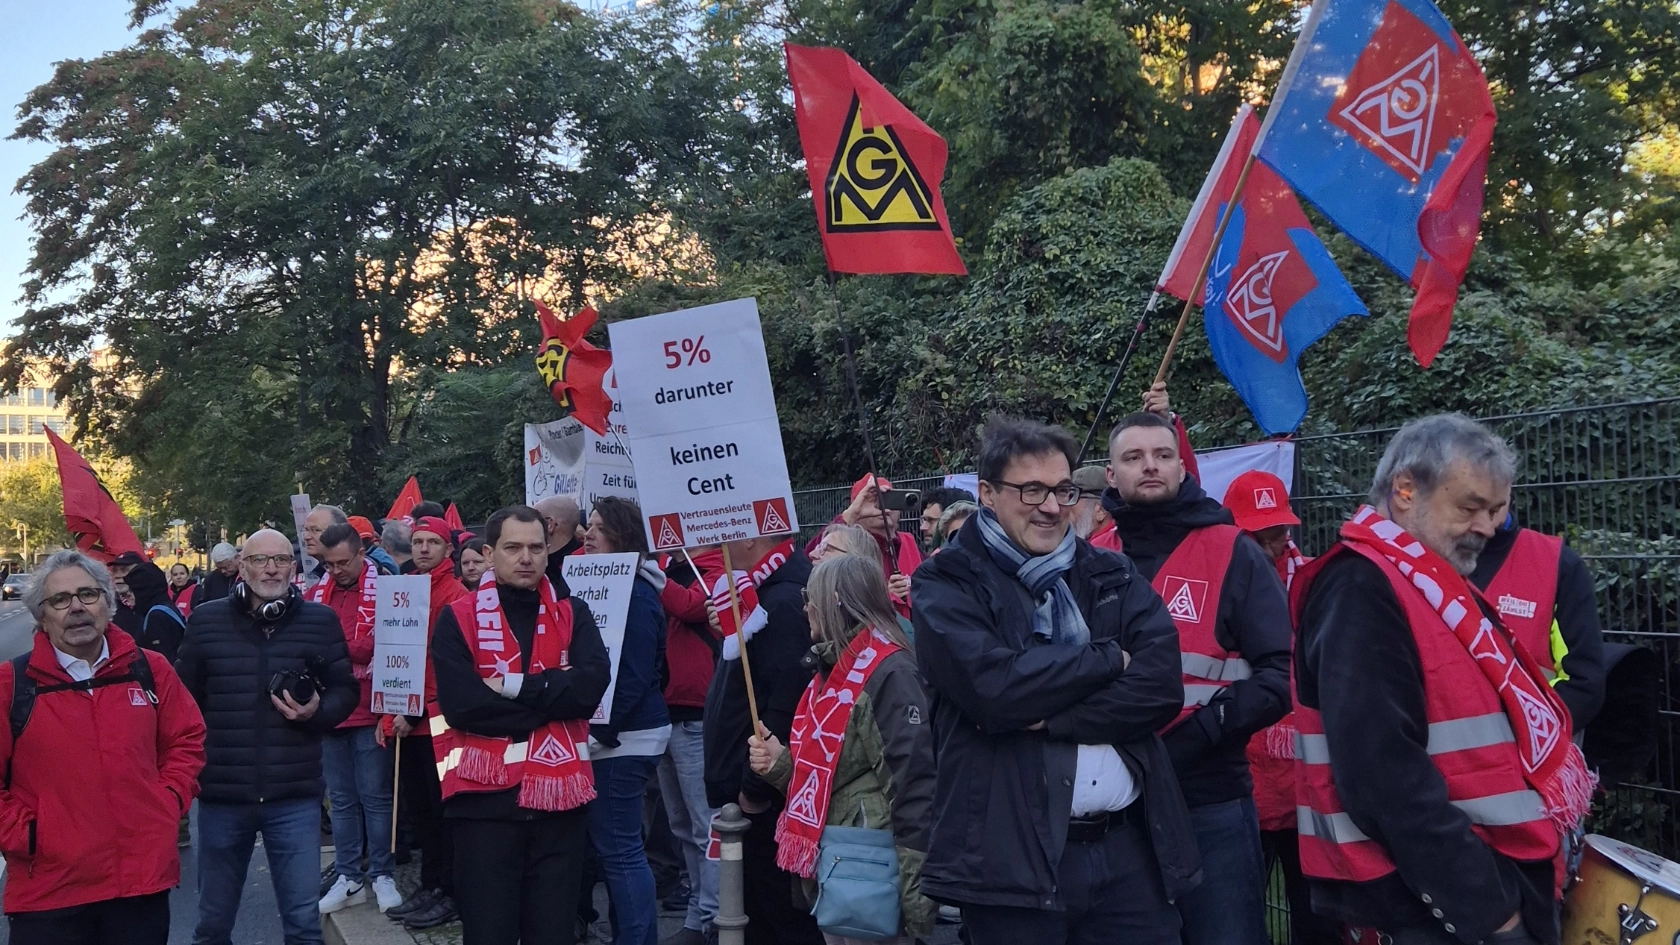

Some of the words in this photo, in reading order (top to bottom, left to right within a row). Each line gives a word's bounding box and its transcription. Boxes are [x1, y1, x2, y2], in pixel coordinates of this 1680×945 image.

[663, 334, 711, 369] 5%
[654, 380, 734, 405] darunter
[670, 442, 739, 466] keinen
[602, 473, 622, 487] Zeit
[687, 473, 735, 495] Cent
[680, 503, 752, 520] Vertrauensleute
[686, 517, 752, 533] Mercedes-Benz
[696, 532, 720, 545] Werk
[721, 530, 747, 541] Berlin
[566, 561, 631, 579] Arbeitsplatz
[392, 591, 410, 608] 5%
[576, 585, 609, 601] erhalt
[383, 617, 400, 627] mehr
[402, 617, 419, 627] Lohn
[386, 655, 409, 669] 100%
[382, 677, 412, 689] verdient
